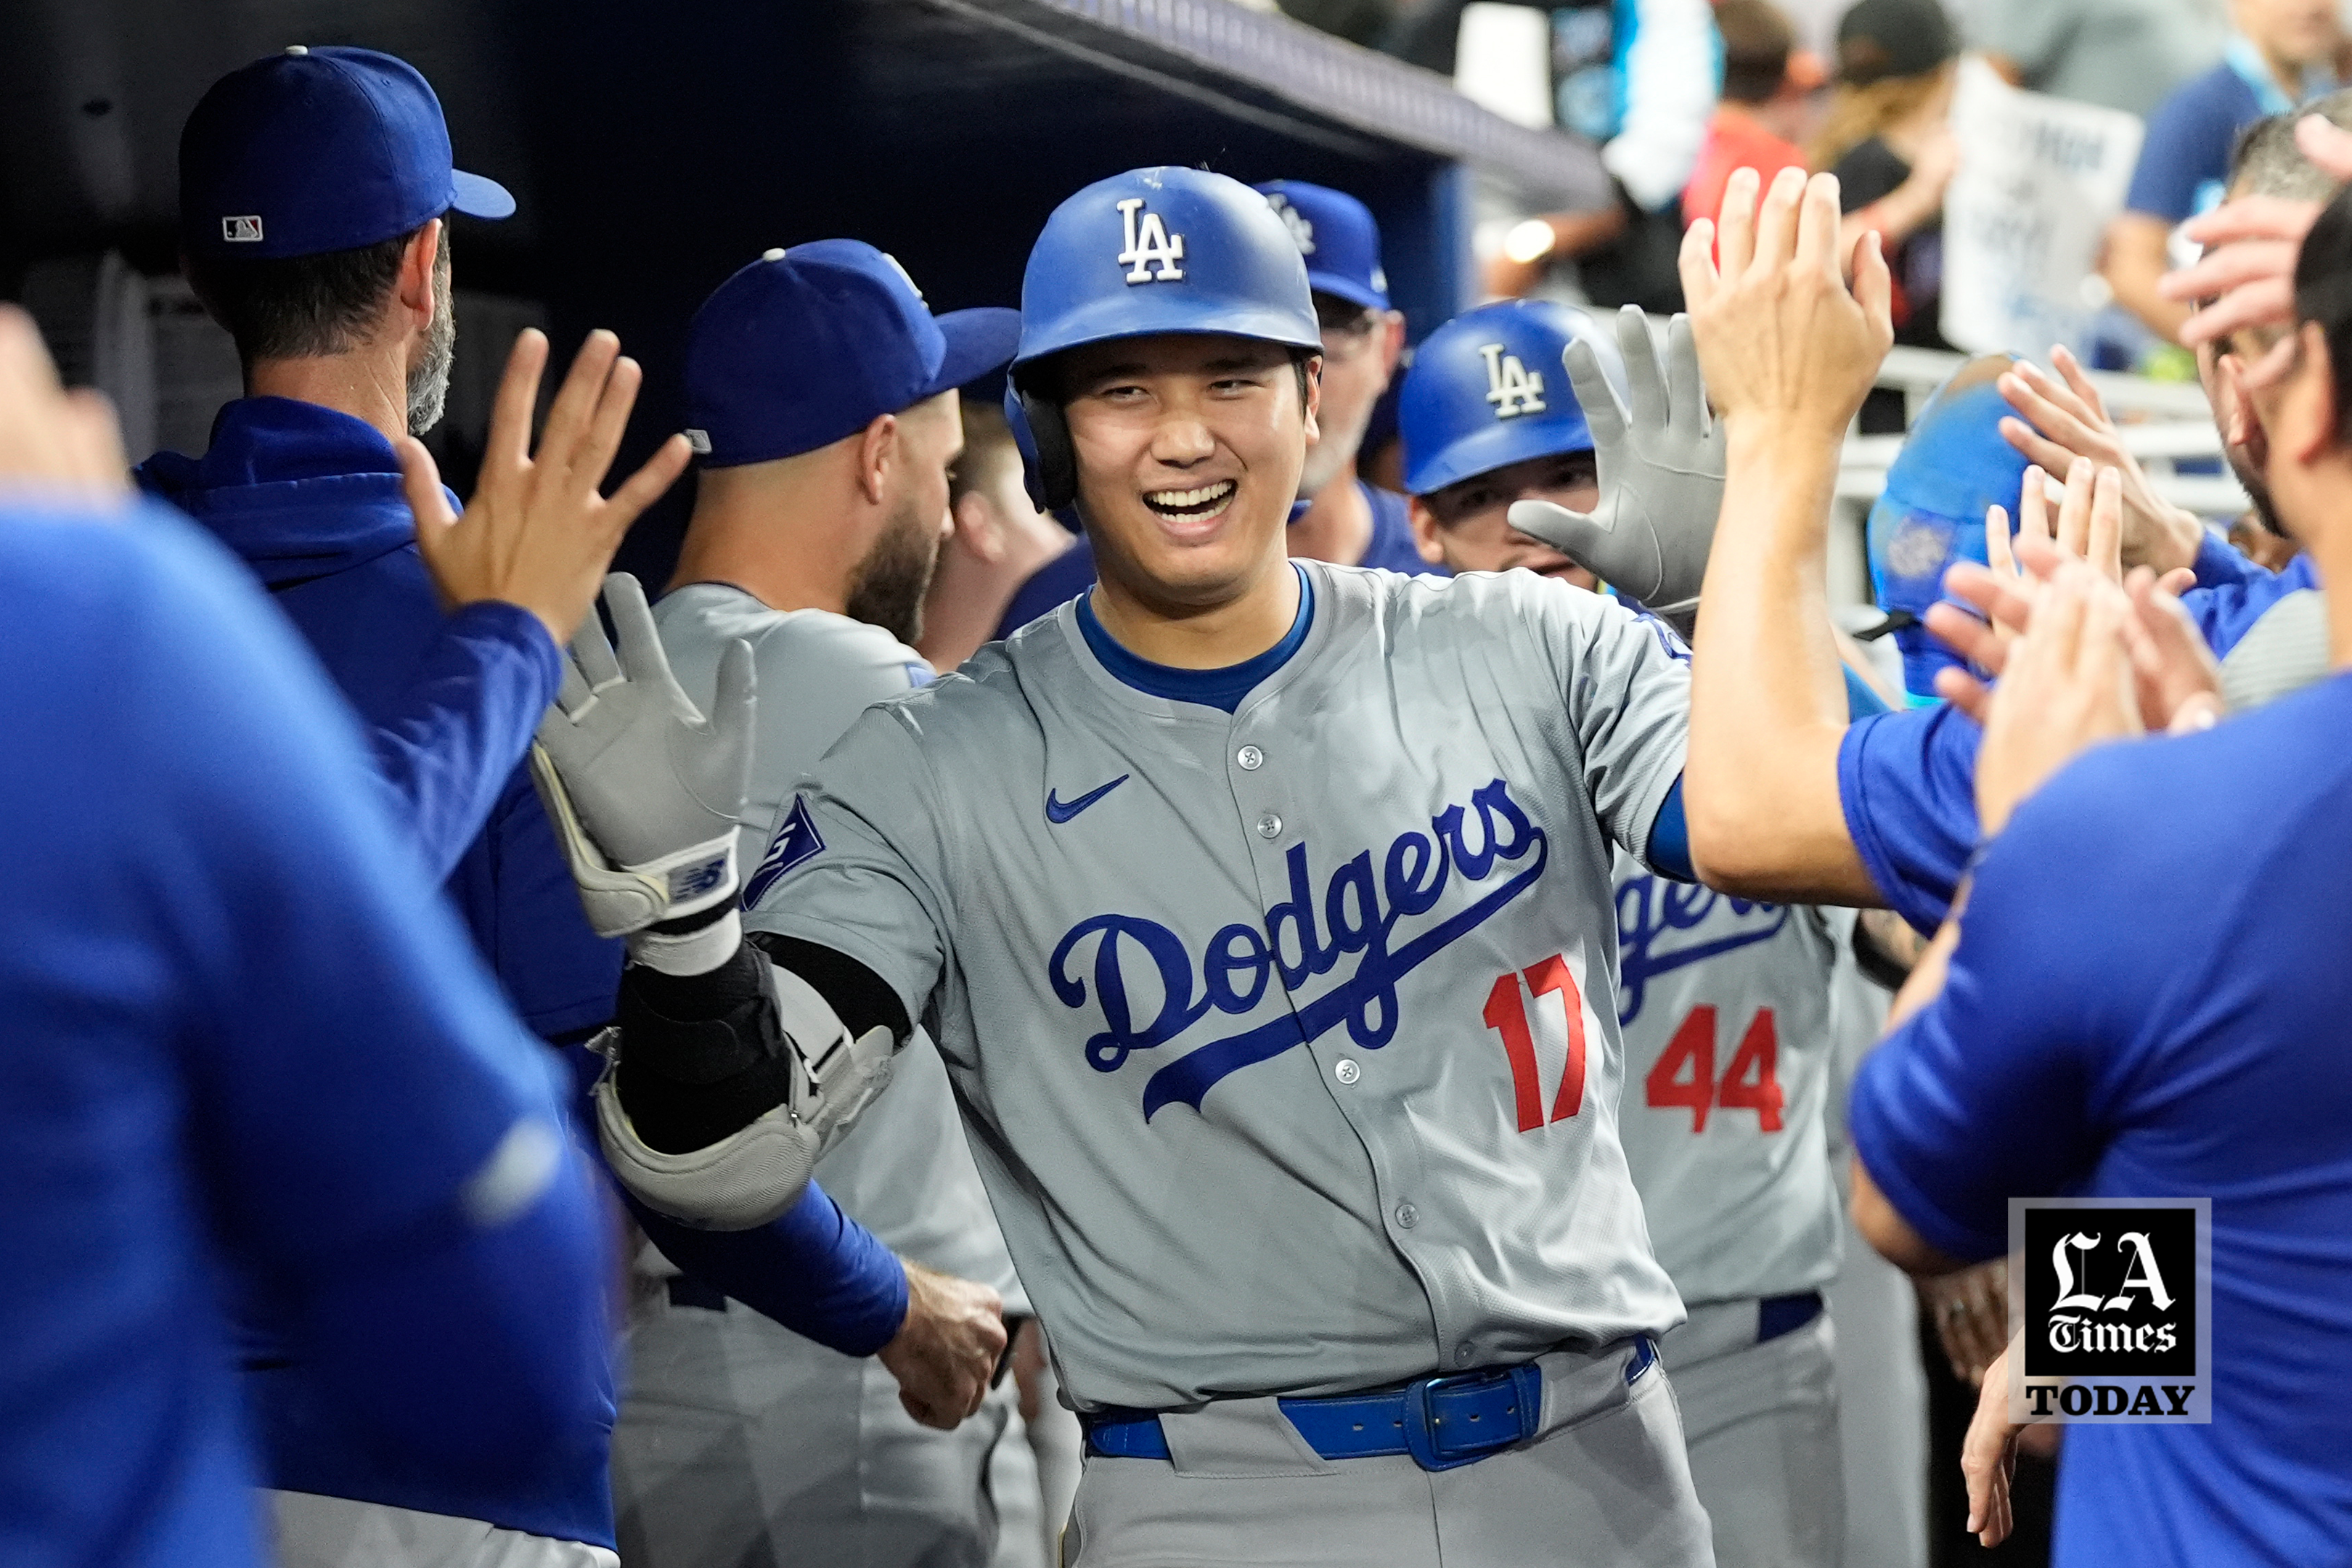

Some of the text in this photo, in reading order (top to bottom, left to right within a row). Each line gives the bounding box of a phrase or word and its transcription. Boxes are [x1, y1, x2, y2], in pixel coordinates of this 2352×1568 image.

[1116, 198, 1184, 283] LA
[1479, 343, 1546, 418] LA
[1049, 778, 1548, 1124] Dodgers
[1483, 953, 1585, 1132] 17
[1643, 1004, 1784, 1134] 44
